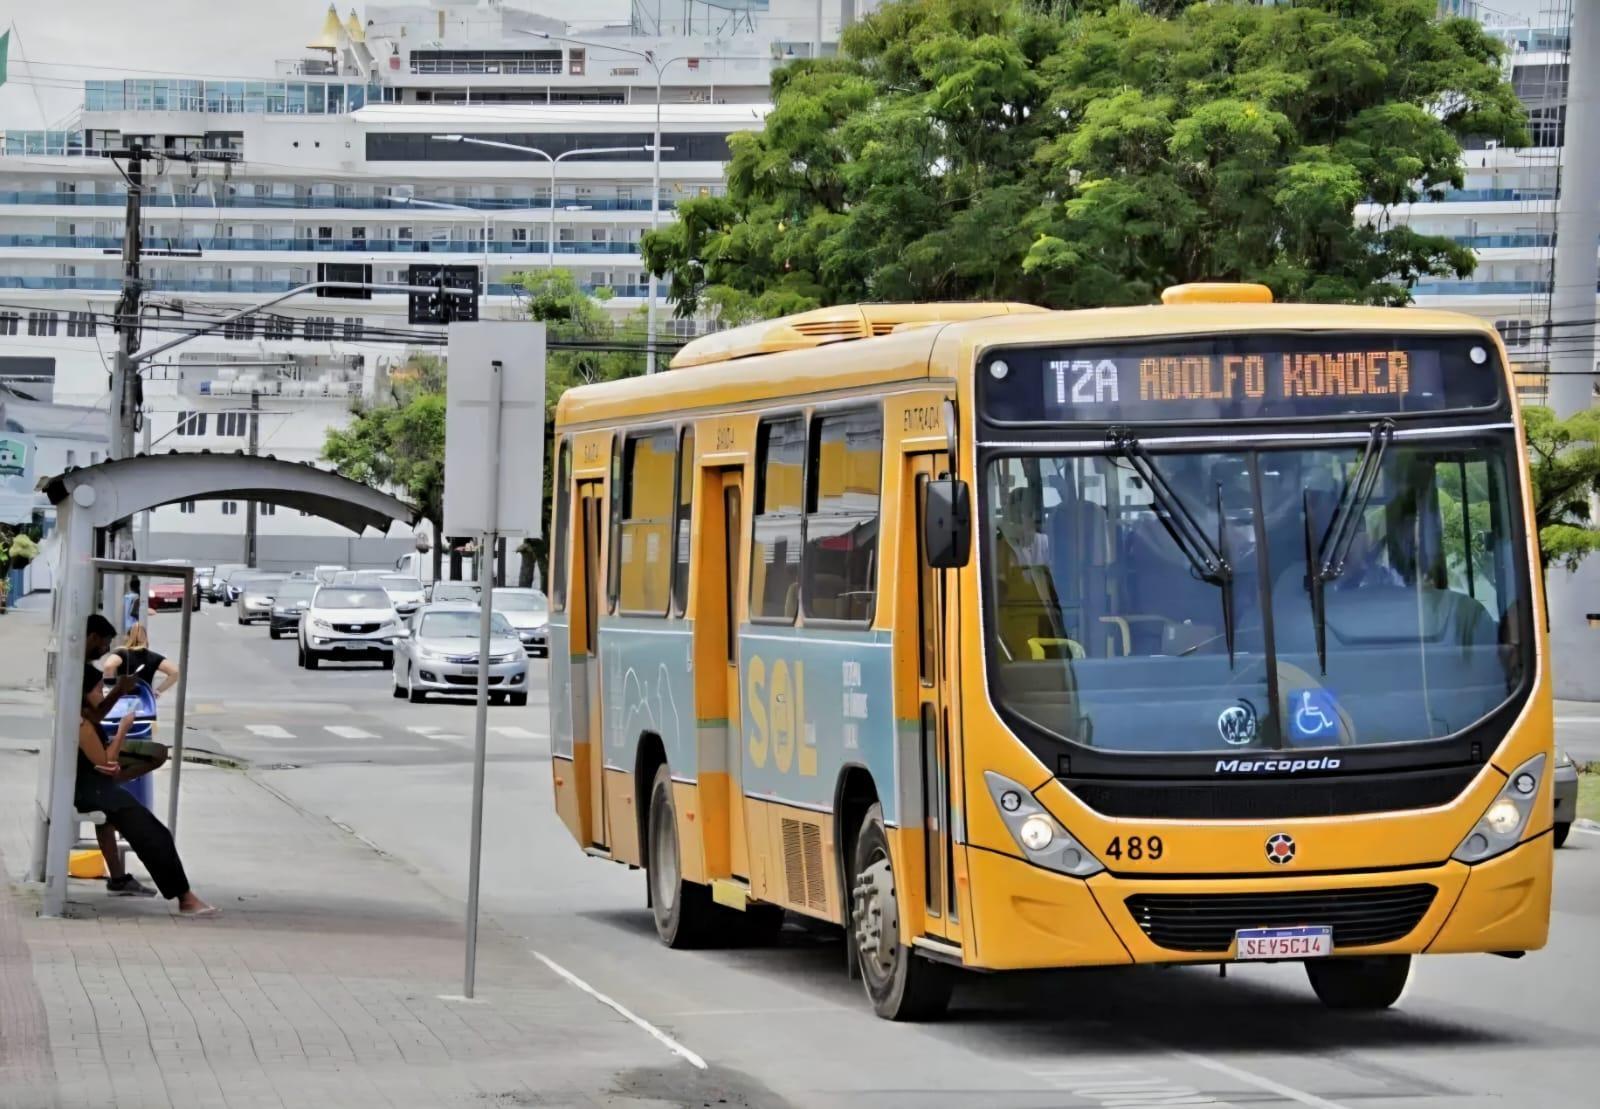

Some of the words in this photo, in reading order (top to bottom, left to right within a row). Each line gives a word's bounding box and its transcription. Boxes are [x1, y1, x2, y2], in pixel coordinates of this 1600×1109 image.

[1050, 359, 1119, 403] T2A
[1139, 355, 1265, 400] ADOLFO
[1283, 351, 1409, 397] KONDER
[747, 654, 817, 776] SOL
[1215, 757, 1341, 773] Marcopolo
[1106, 836, 1163, 860] 489
[1247, 937, 1321, 955] SEY5C14
